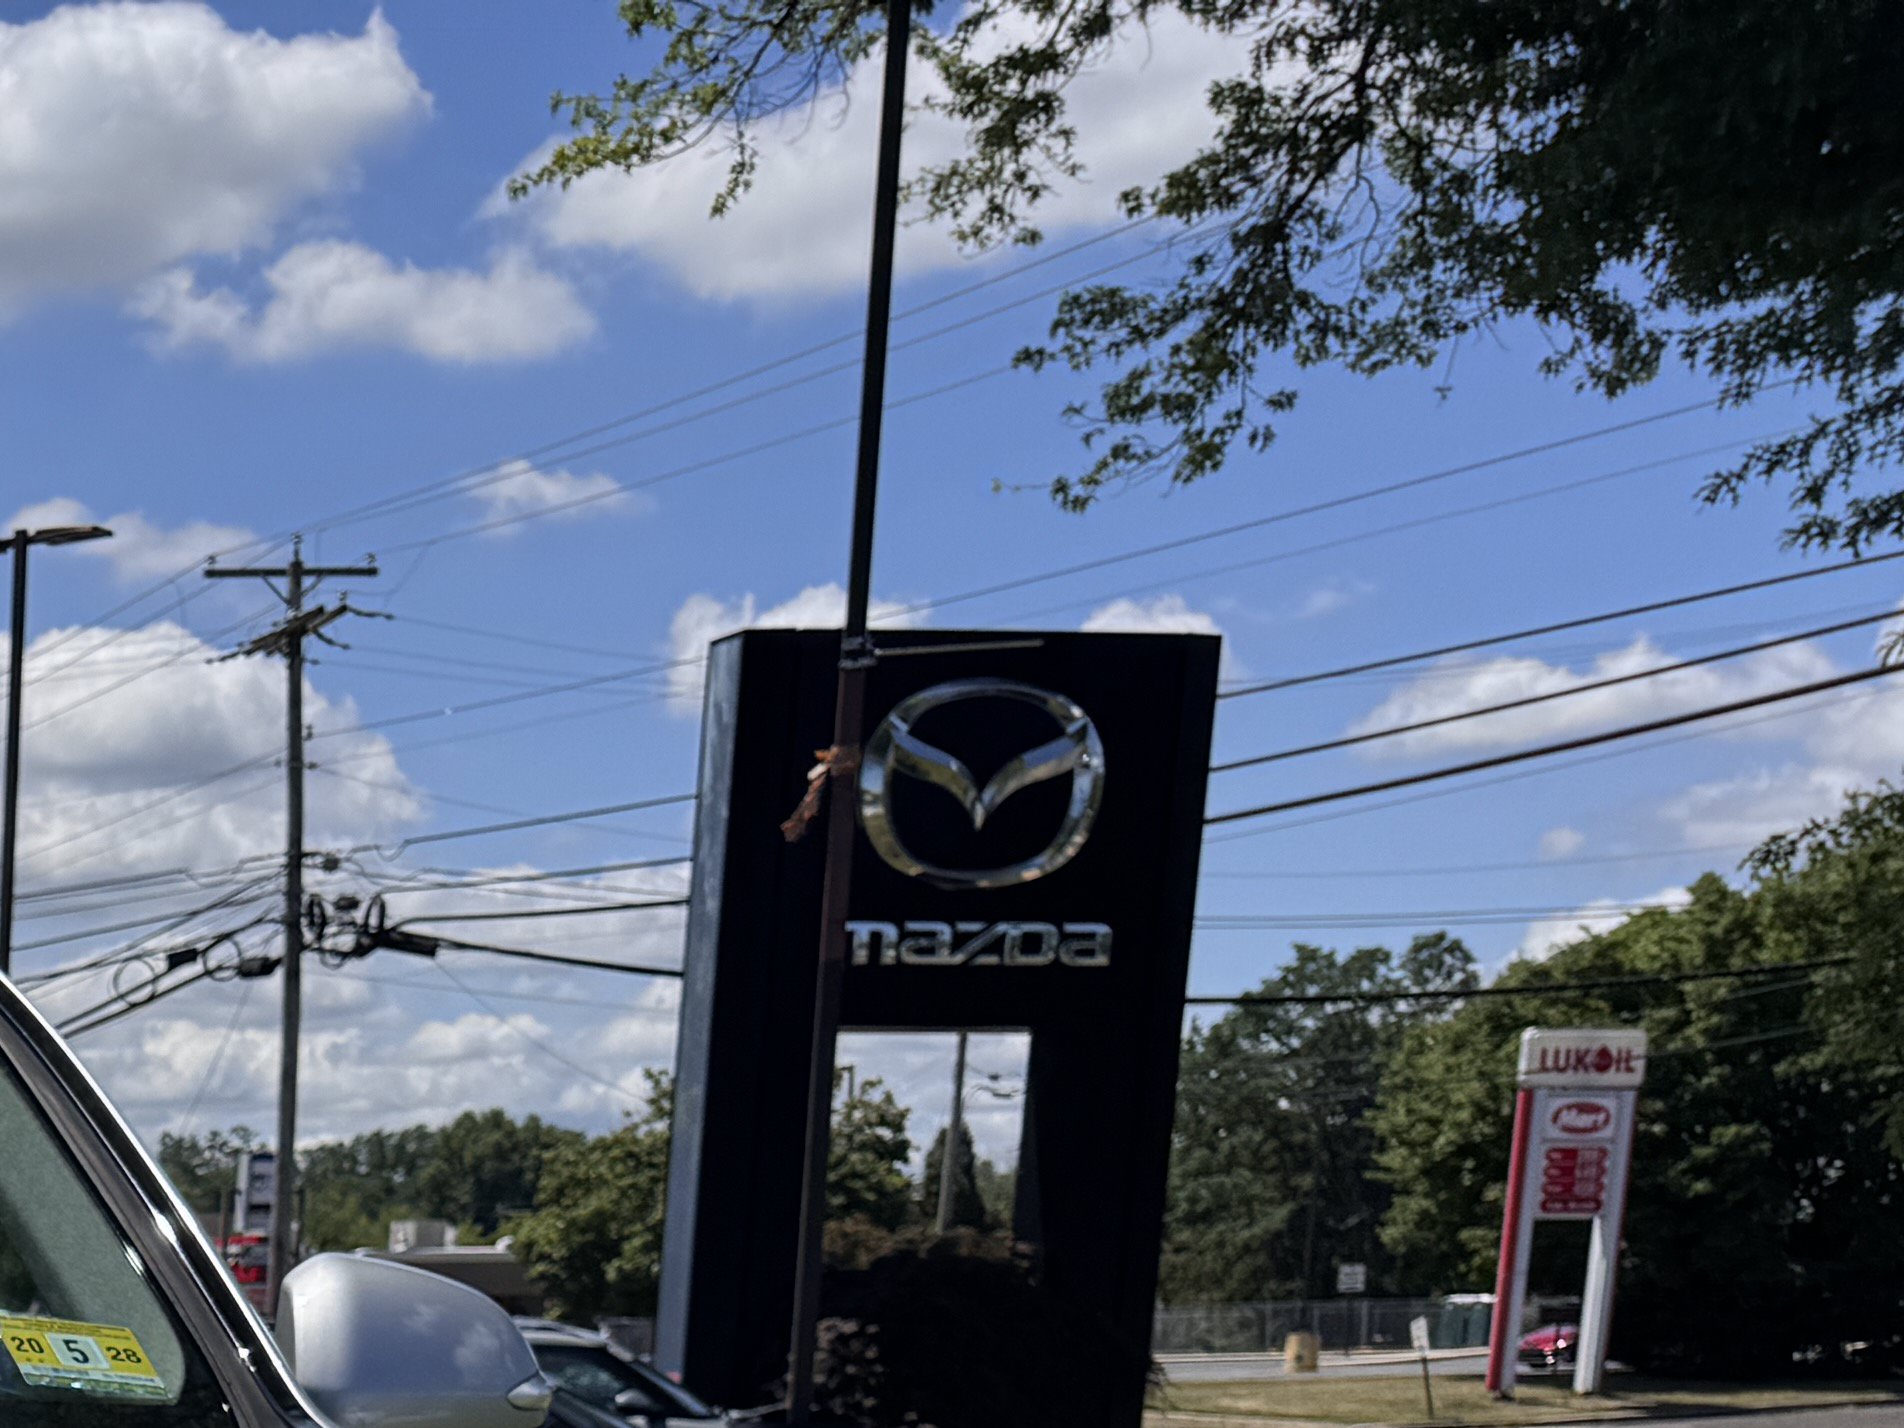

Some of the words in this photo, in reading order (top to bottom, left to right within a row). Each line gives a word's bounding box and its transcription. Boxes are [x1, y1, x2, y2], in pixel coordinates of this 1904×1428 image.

[1539, 1045, 1635, 1073] LUKOIL
[11, 1336, 44, 1354] 20
[63, 1339, 89, 1364] 5
[106, 1346, 142, 1363] 28
